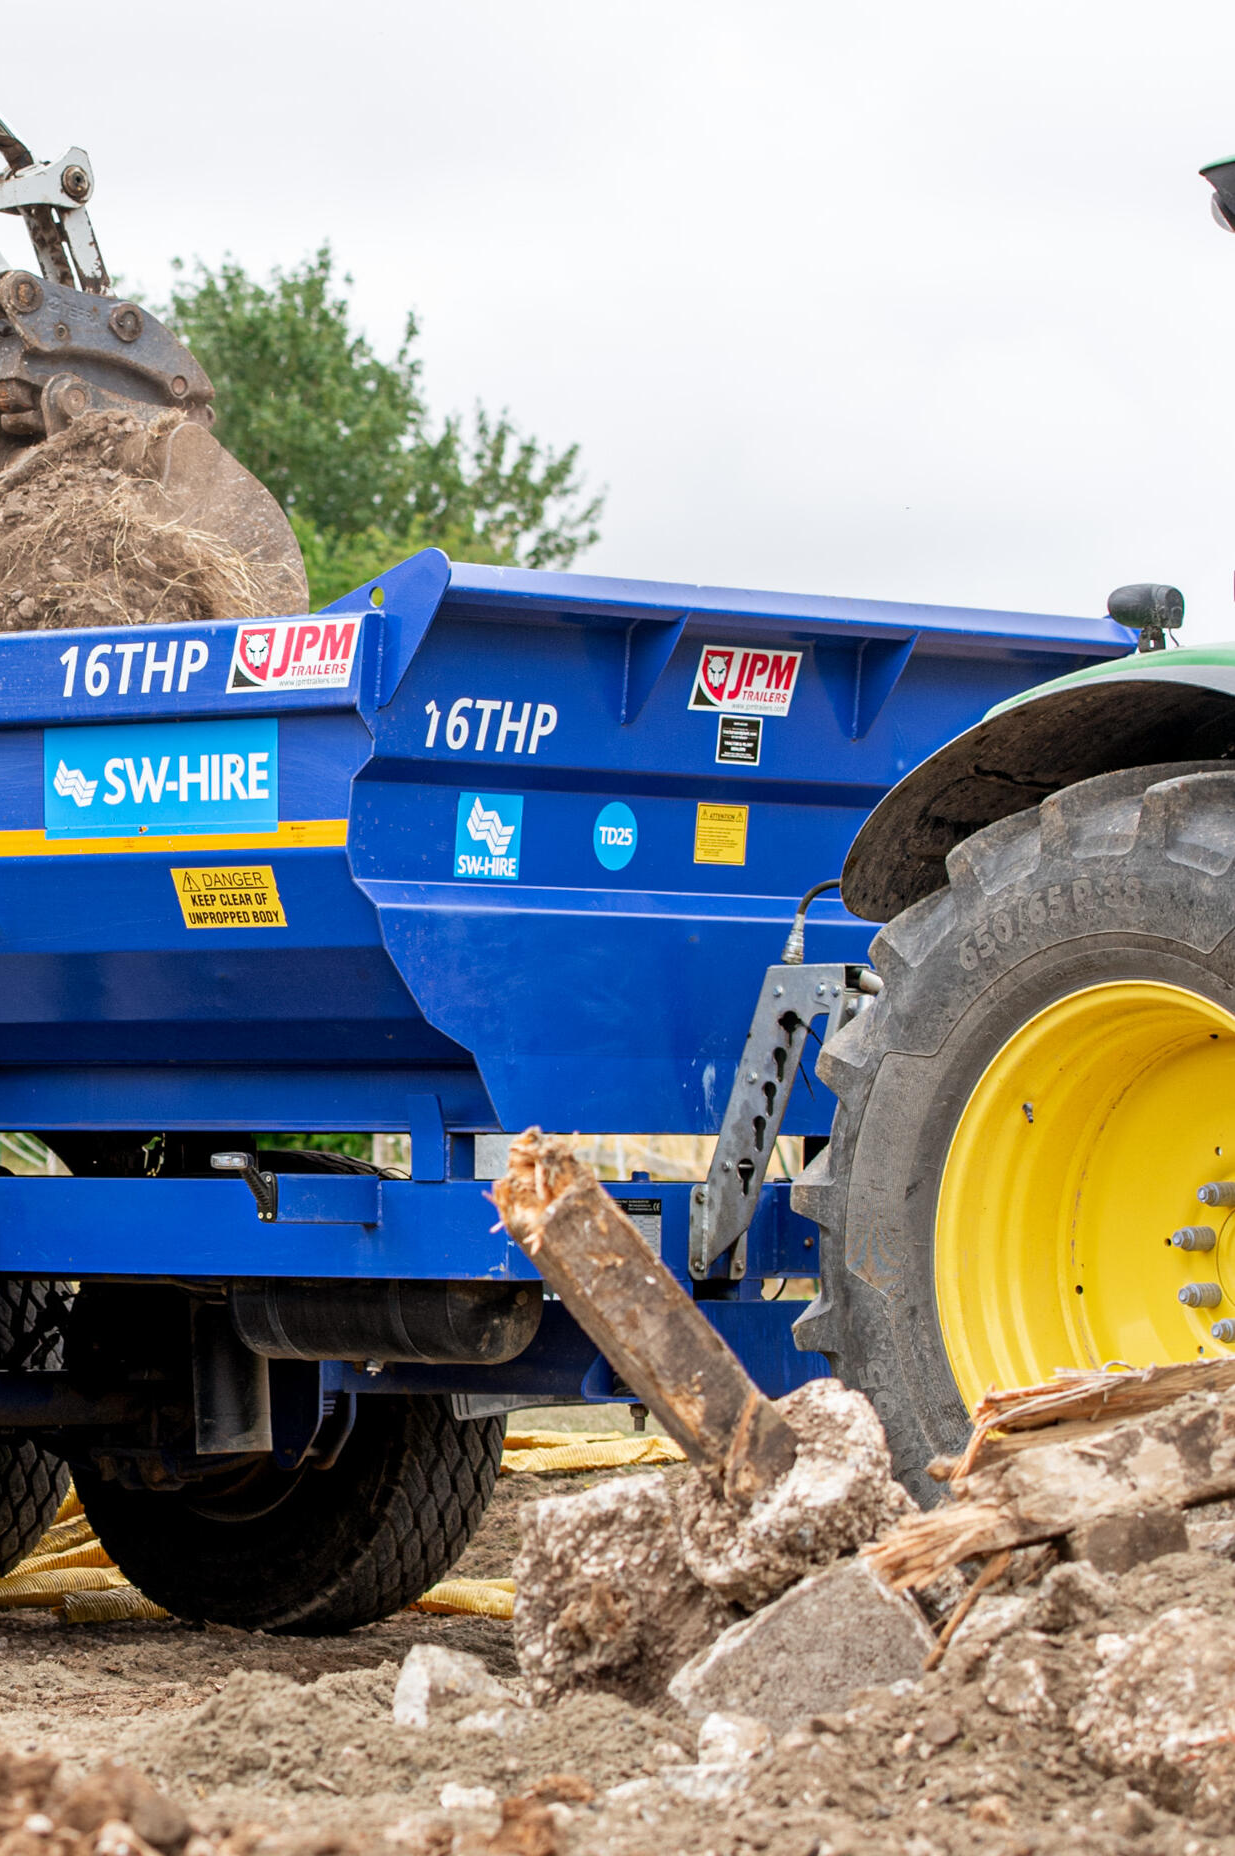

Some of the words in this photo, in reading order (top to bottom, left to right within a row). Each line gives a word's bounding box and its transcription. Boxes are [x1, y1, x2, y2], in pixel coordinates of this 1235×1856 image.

[272, 623, 356, 678] JPM
[59, 640, 209, 698] 16THP
[291, 663, 347, 677] TRAILERS
[727, 652, 798, 700] JPM
[742, 690, 788, 704] TRAILERS
[424, 697, 558, 755] 16THP
[103, 752, 269, 805] SW-HIRE
[599, 826, 633, 846] TD25
[457, 855, 517, 877] SW-HIRE
[201, 871, 265, 888] DANGER
[190, 894, 217, 907] KEEP
[219, 893, 253, 907] CLEAR
[254, 892, 269, 906] OF
[188, 911, 251, 925] UNPROPPED
[252, 910, 280, 924] BODY
